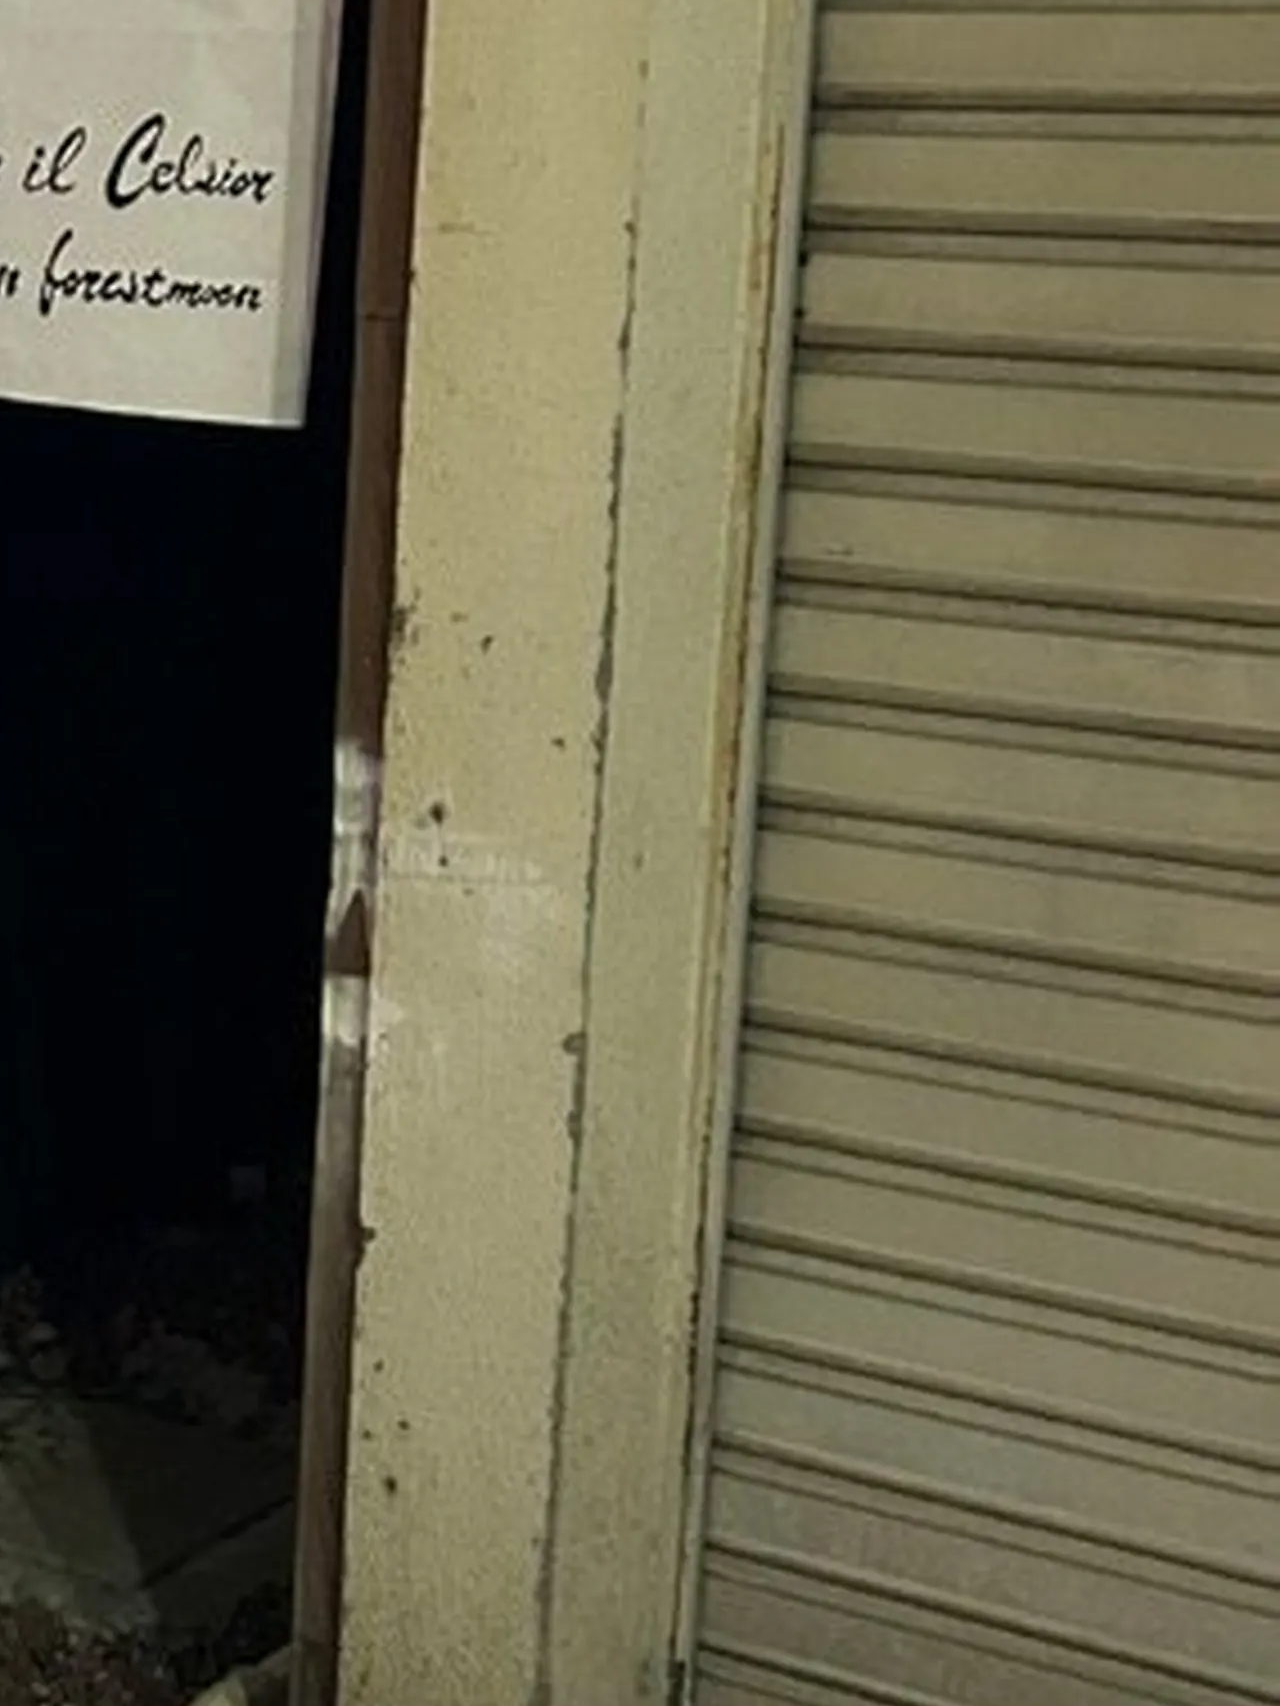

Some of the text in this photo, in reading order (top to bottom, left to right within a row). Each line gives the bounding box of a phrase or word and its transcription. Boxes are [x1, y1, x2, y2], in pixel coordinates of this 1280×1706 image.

[22, 126, 87, 195] il
[105, 113, 274, 210] Celsior
[39, 229, 263, 317] forestmoon
